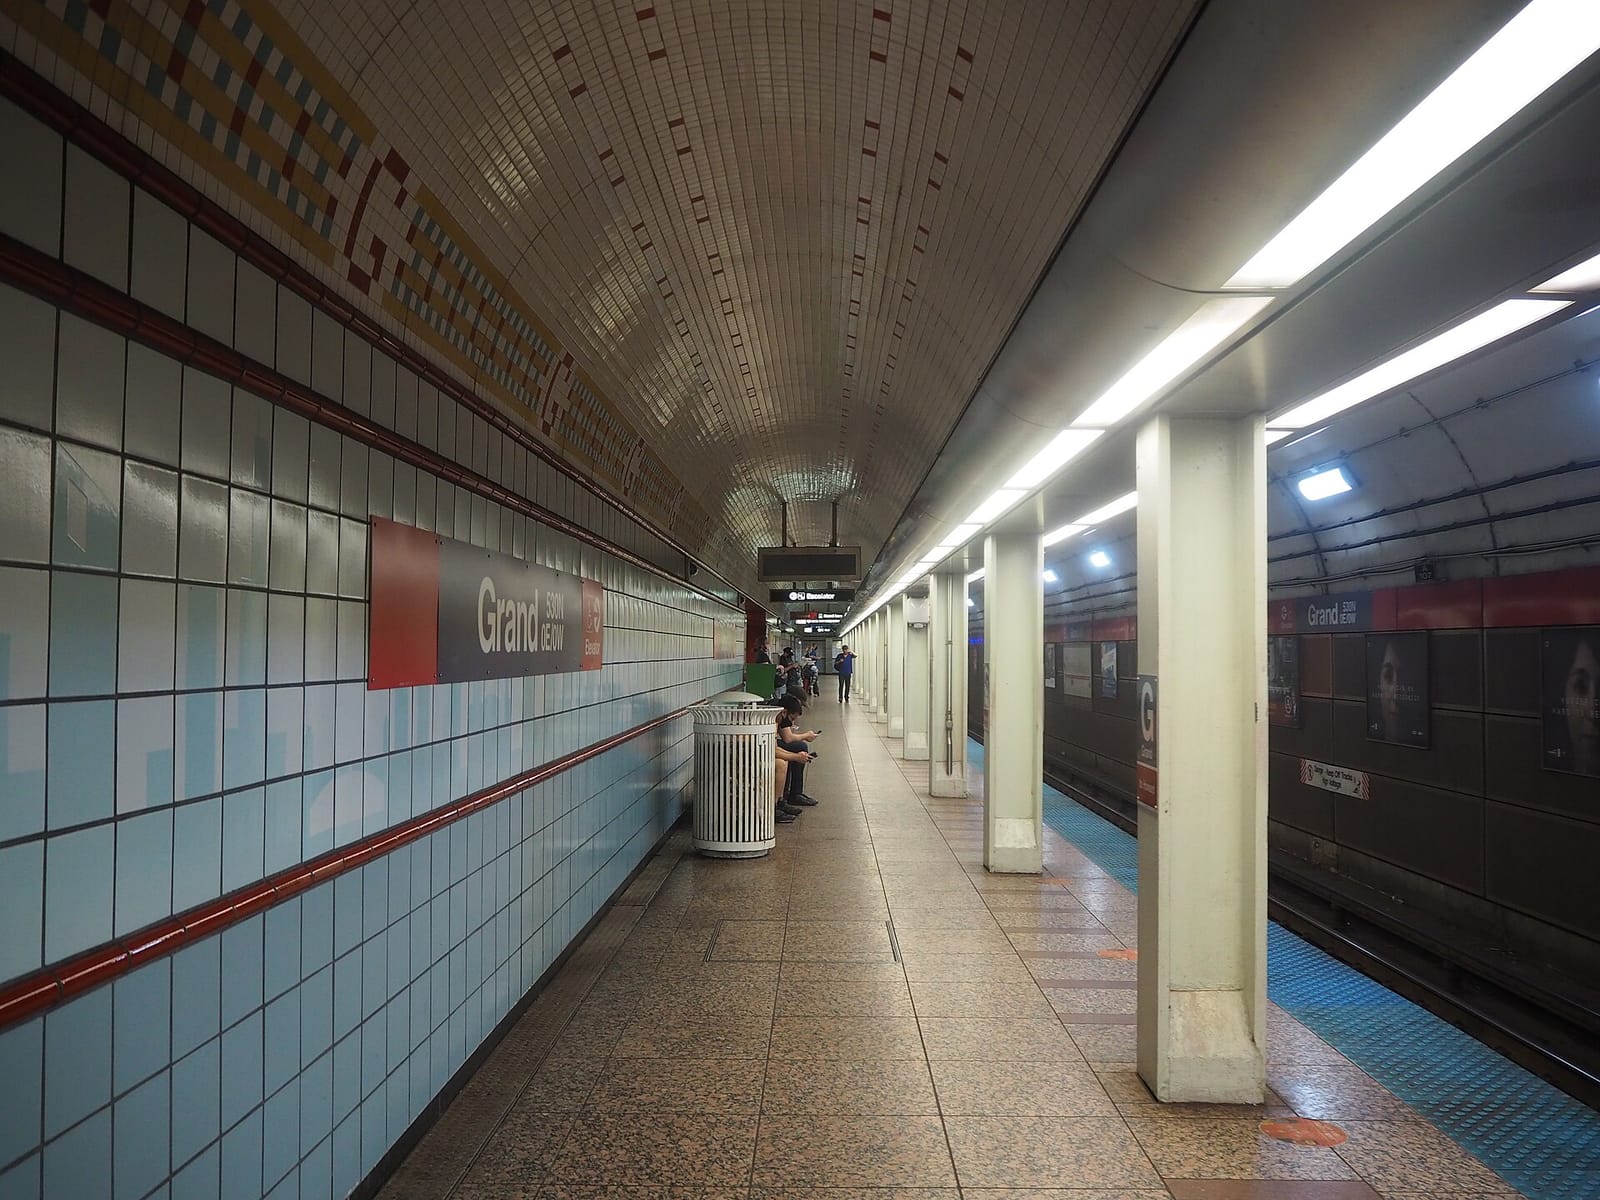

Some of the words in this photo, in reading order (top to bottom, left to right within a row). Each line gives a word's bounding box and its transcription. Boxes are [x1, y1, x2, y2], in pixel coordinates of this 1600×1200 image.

[477, 576, 539, 654] Grand
[546, 591, 565, 619] 530N
[1307, 602, 1339, 626] Grand
[1342, 600, 1357, 612] 530N
[541, 622, 565, 652] 0E/0W
[1141, 681, 1154, 743] G
